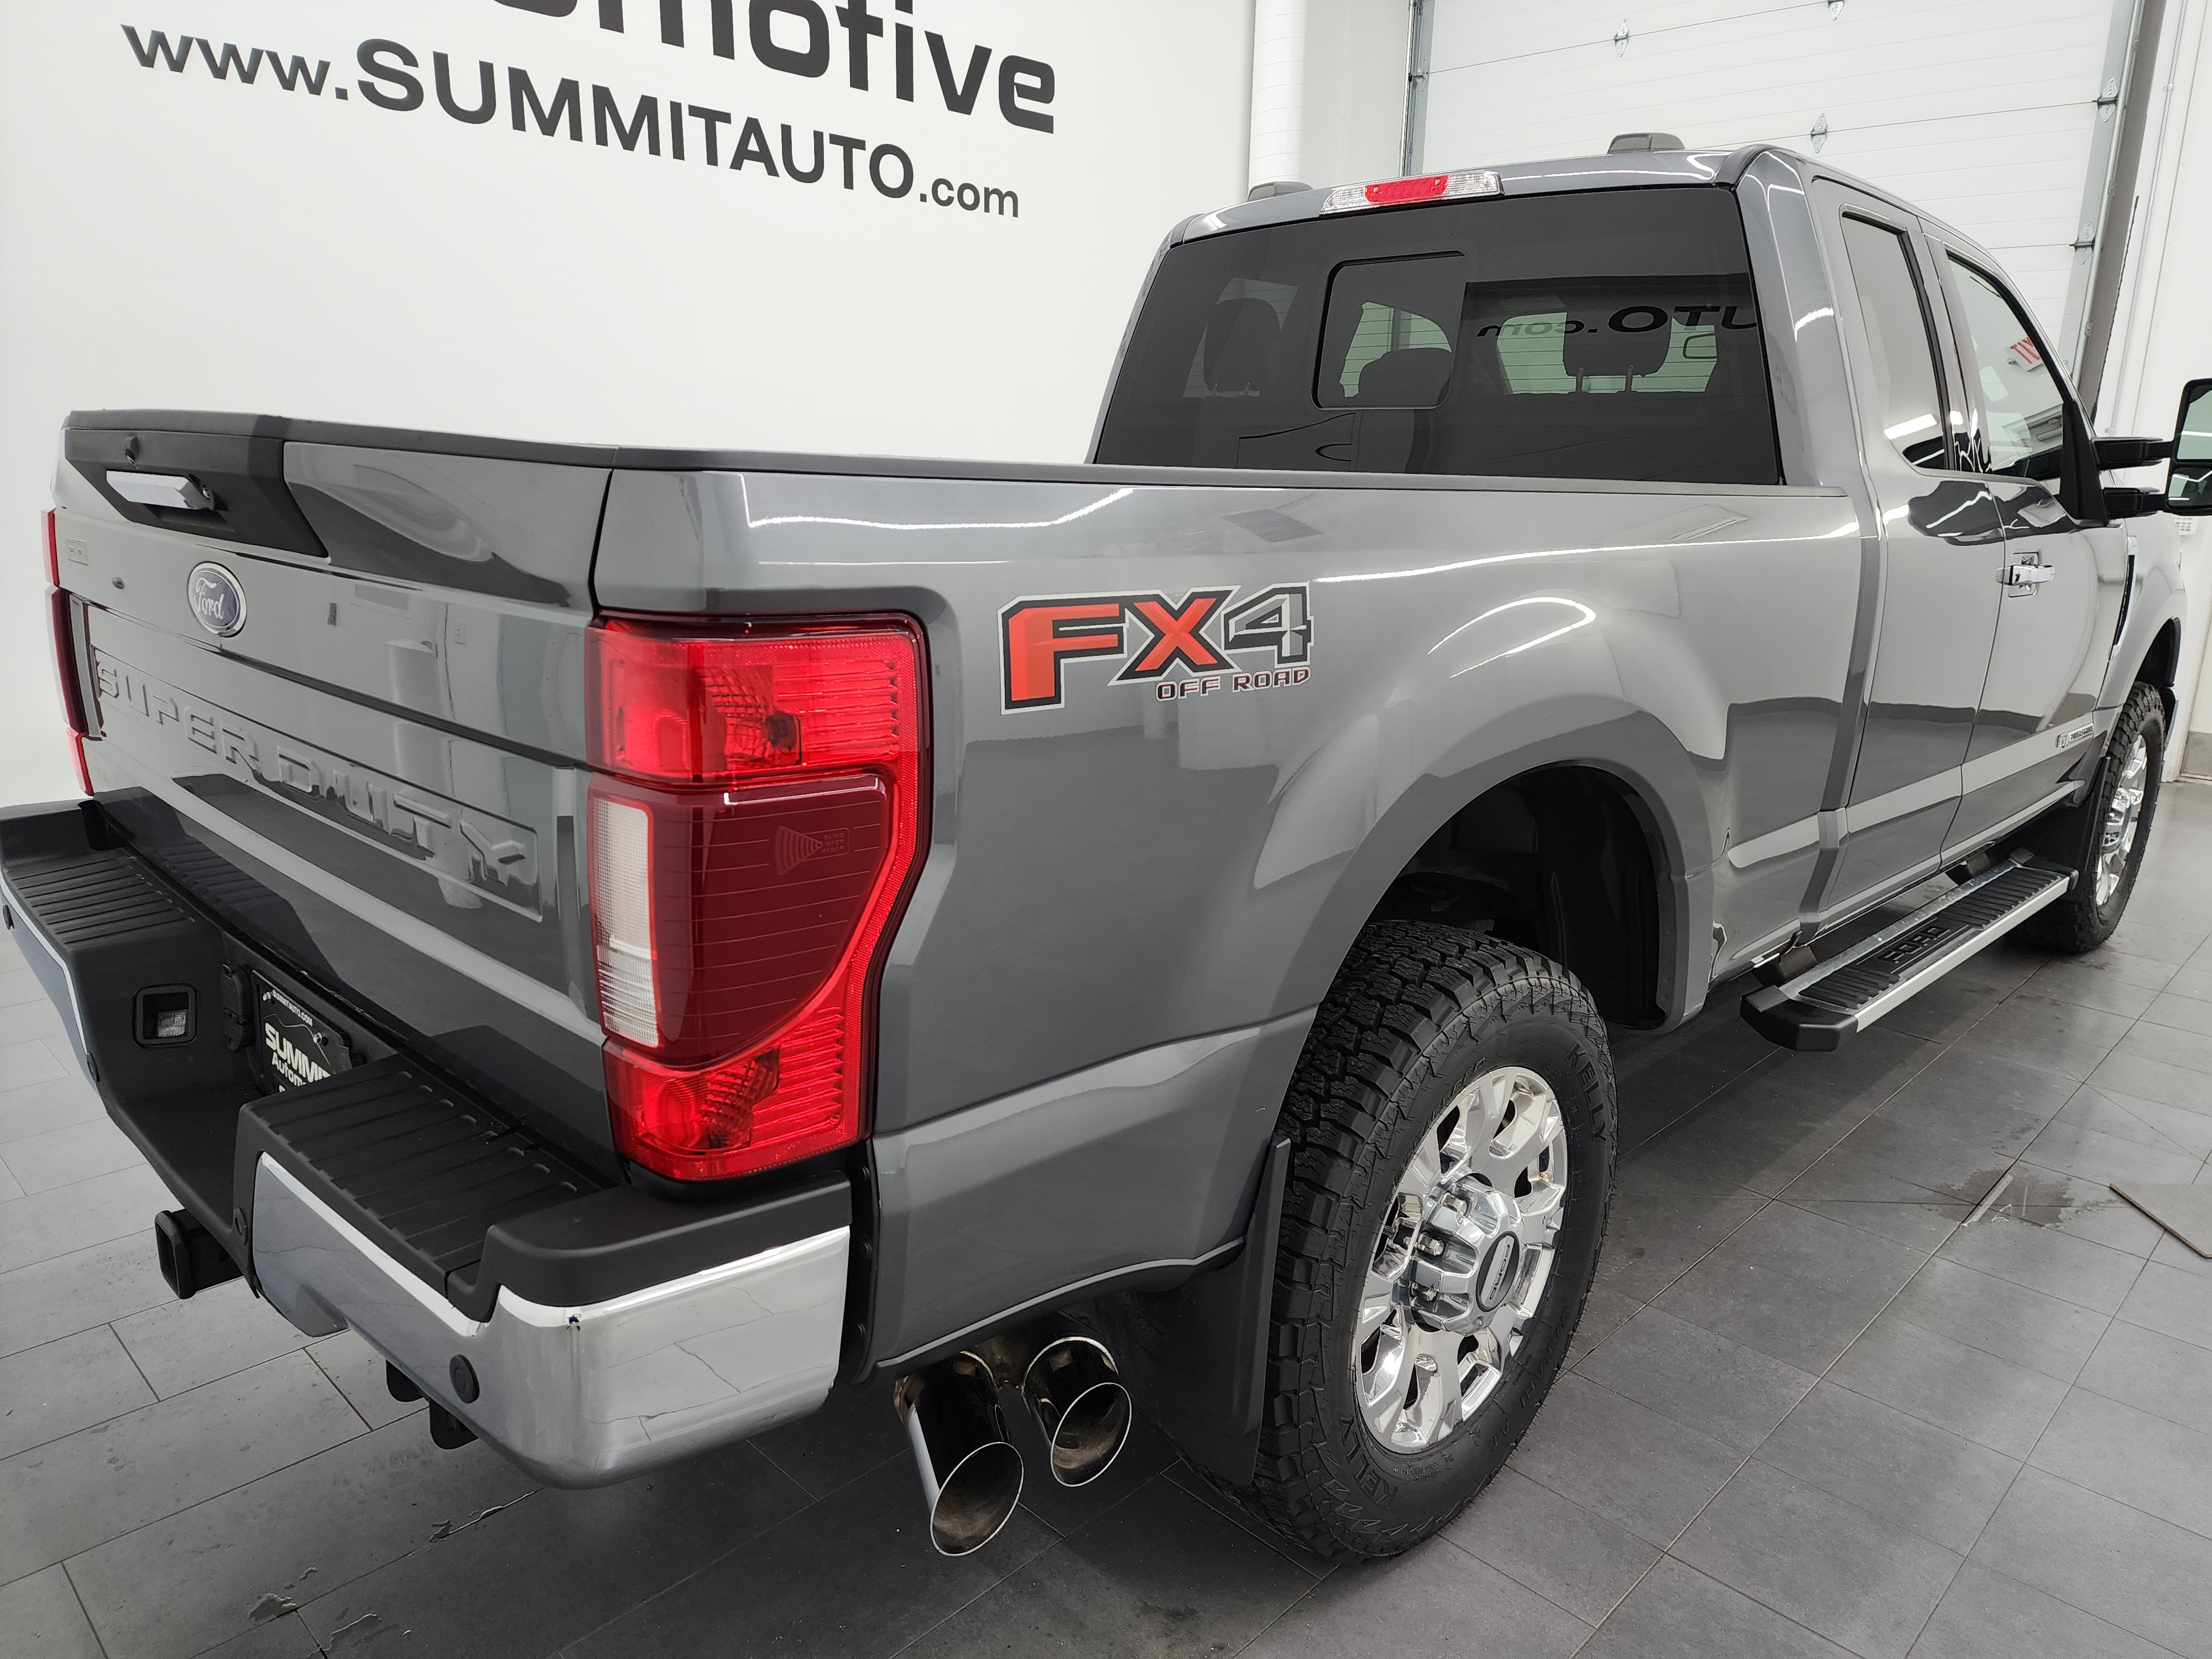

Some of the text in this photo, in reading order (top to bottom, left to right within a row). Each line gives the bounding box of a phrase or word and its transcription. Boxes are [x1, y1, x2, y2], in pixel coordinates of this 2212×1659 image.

[494, 0, 1055, 134] otive
[121, 24, 1019, 218] www.SUMMITAUTO.com
[194, 576, 225, 620] Ford
[997, 581, 1314, 715] FX4
[1156, 666, 1311, 701] OFF ROAD
[97, 667, 527, 886] SUPER DUTY
[1877, 927, 1951, 964] FORD
[265, 1022, 331, 1083] SUMMI
[272, 1051, 307, 1087] Autom
[1564, 1042, 1607, 1143] KELLY
[1489, 1244, 1510, 1301] FORD
[1340, 1414, 1399, 1509] KELLY
